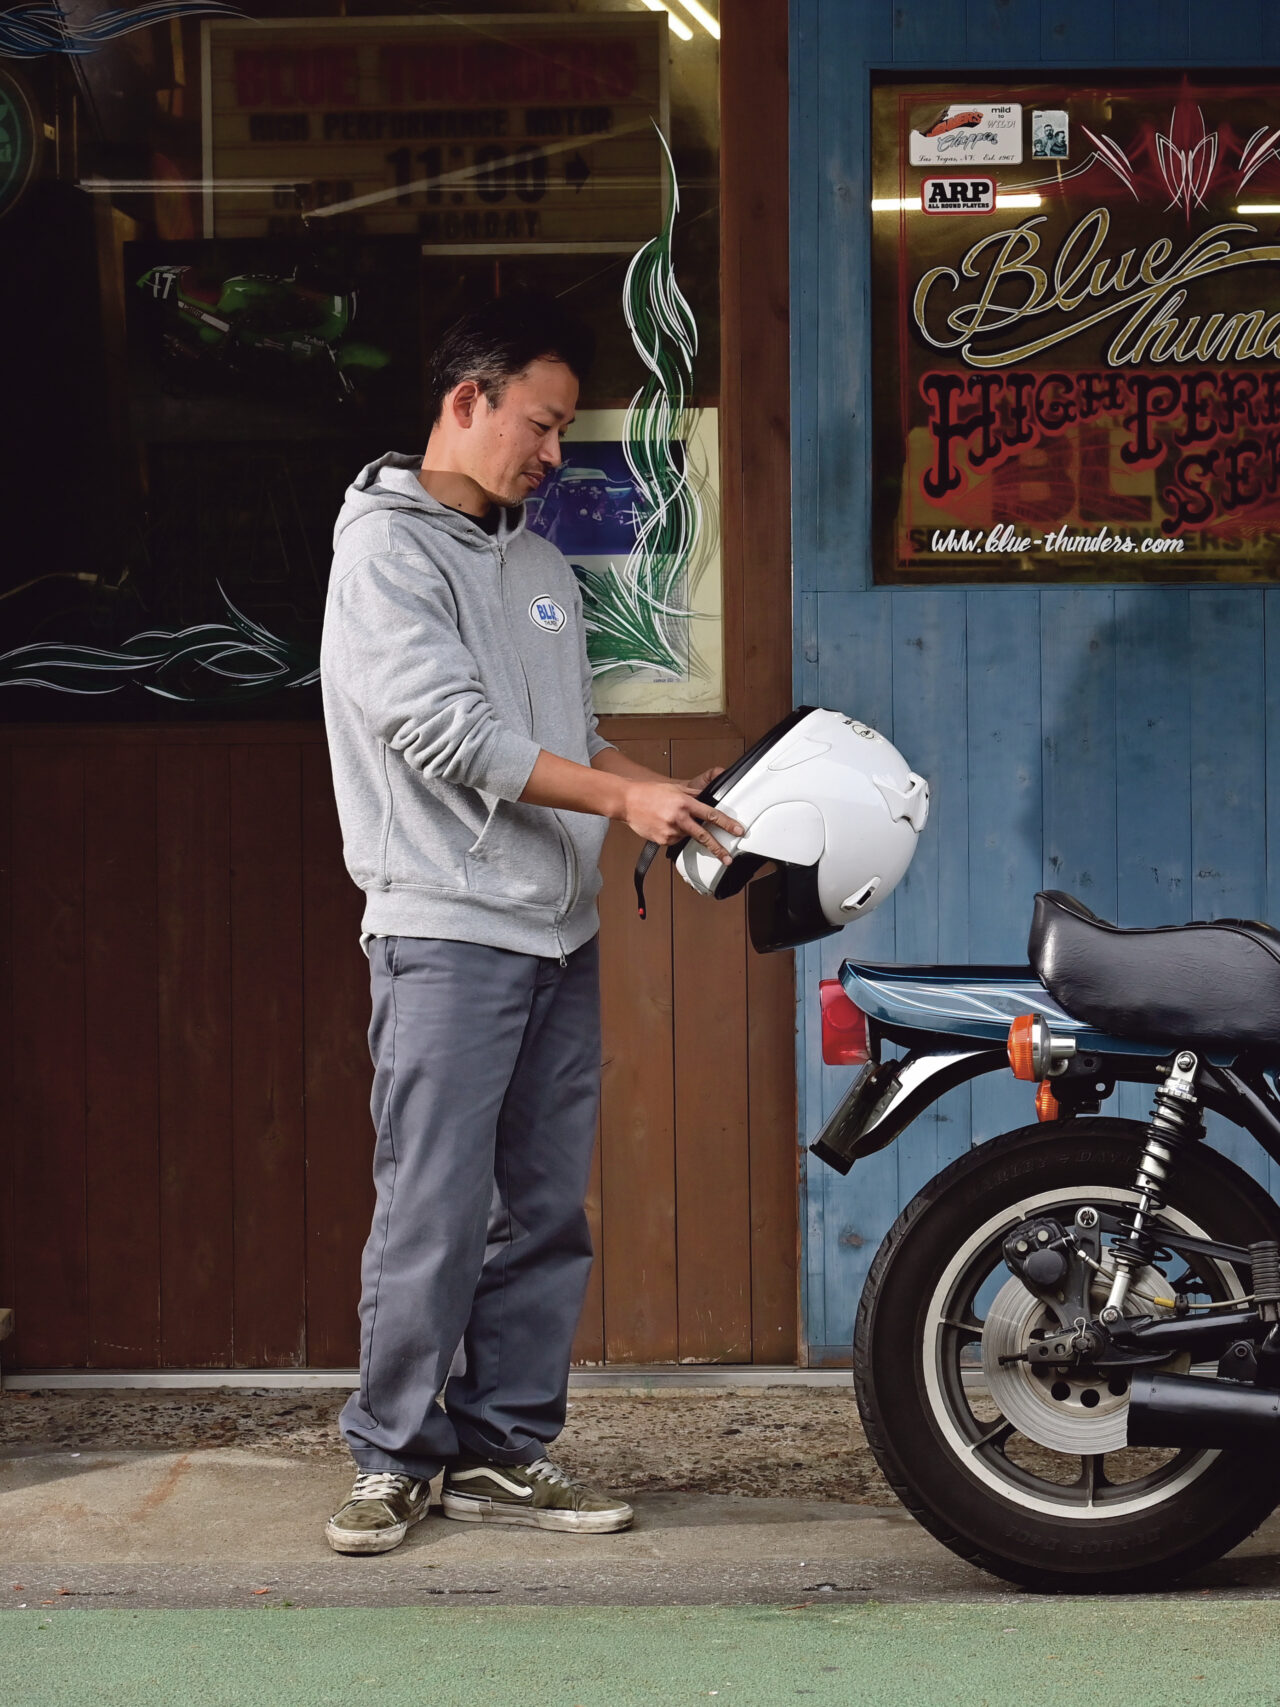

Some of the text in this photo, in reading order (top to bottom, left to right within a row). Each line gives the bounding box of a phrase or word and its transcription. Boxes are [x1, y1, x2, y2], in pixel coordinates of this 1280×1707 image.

[234, 47, 357, 105] BLUE
[991, 106, 1012, 114] mild
[385, 145, 547, 205] 11:00
[928, 182, 990, 203] ARP
[914, 207, 1200, 349] Blue
[921, 373, 1123, 500] HIGH
